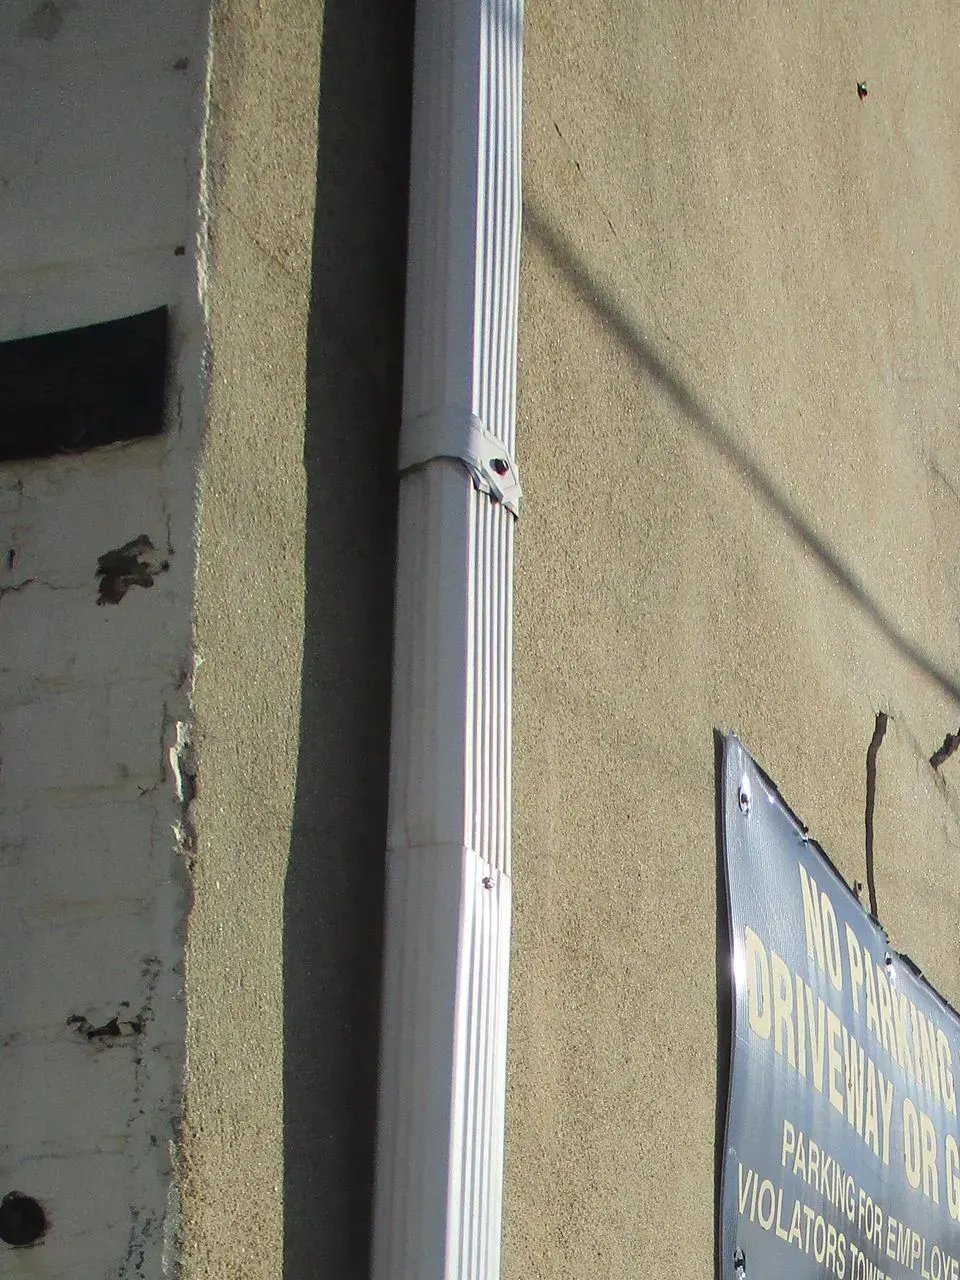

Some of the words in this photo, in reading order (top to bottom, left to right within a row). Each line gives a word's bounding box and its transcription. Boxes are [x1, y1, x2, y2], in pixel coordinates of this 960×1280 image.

[745, 925, 894, 1166] DRIVEWAY
[903, 1097, 939, 1205] OR
[798, 862, 842, 992] NO
[844, 920, 957, 1117] PARKING
[737, 1161, 847, 1279] VIOLATORS
[781, 1119, 856, 1223] PARKING
[858, 1188, 883, 1250] FOR
